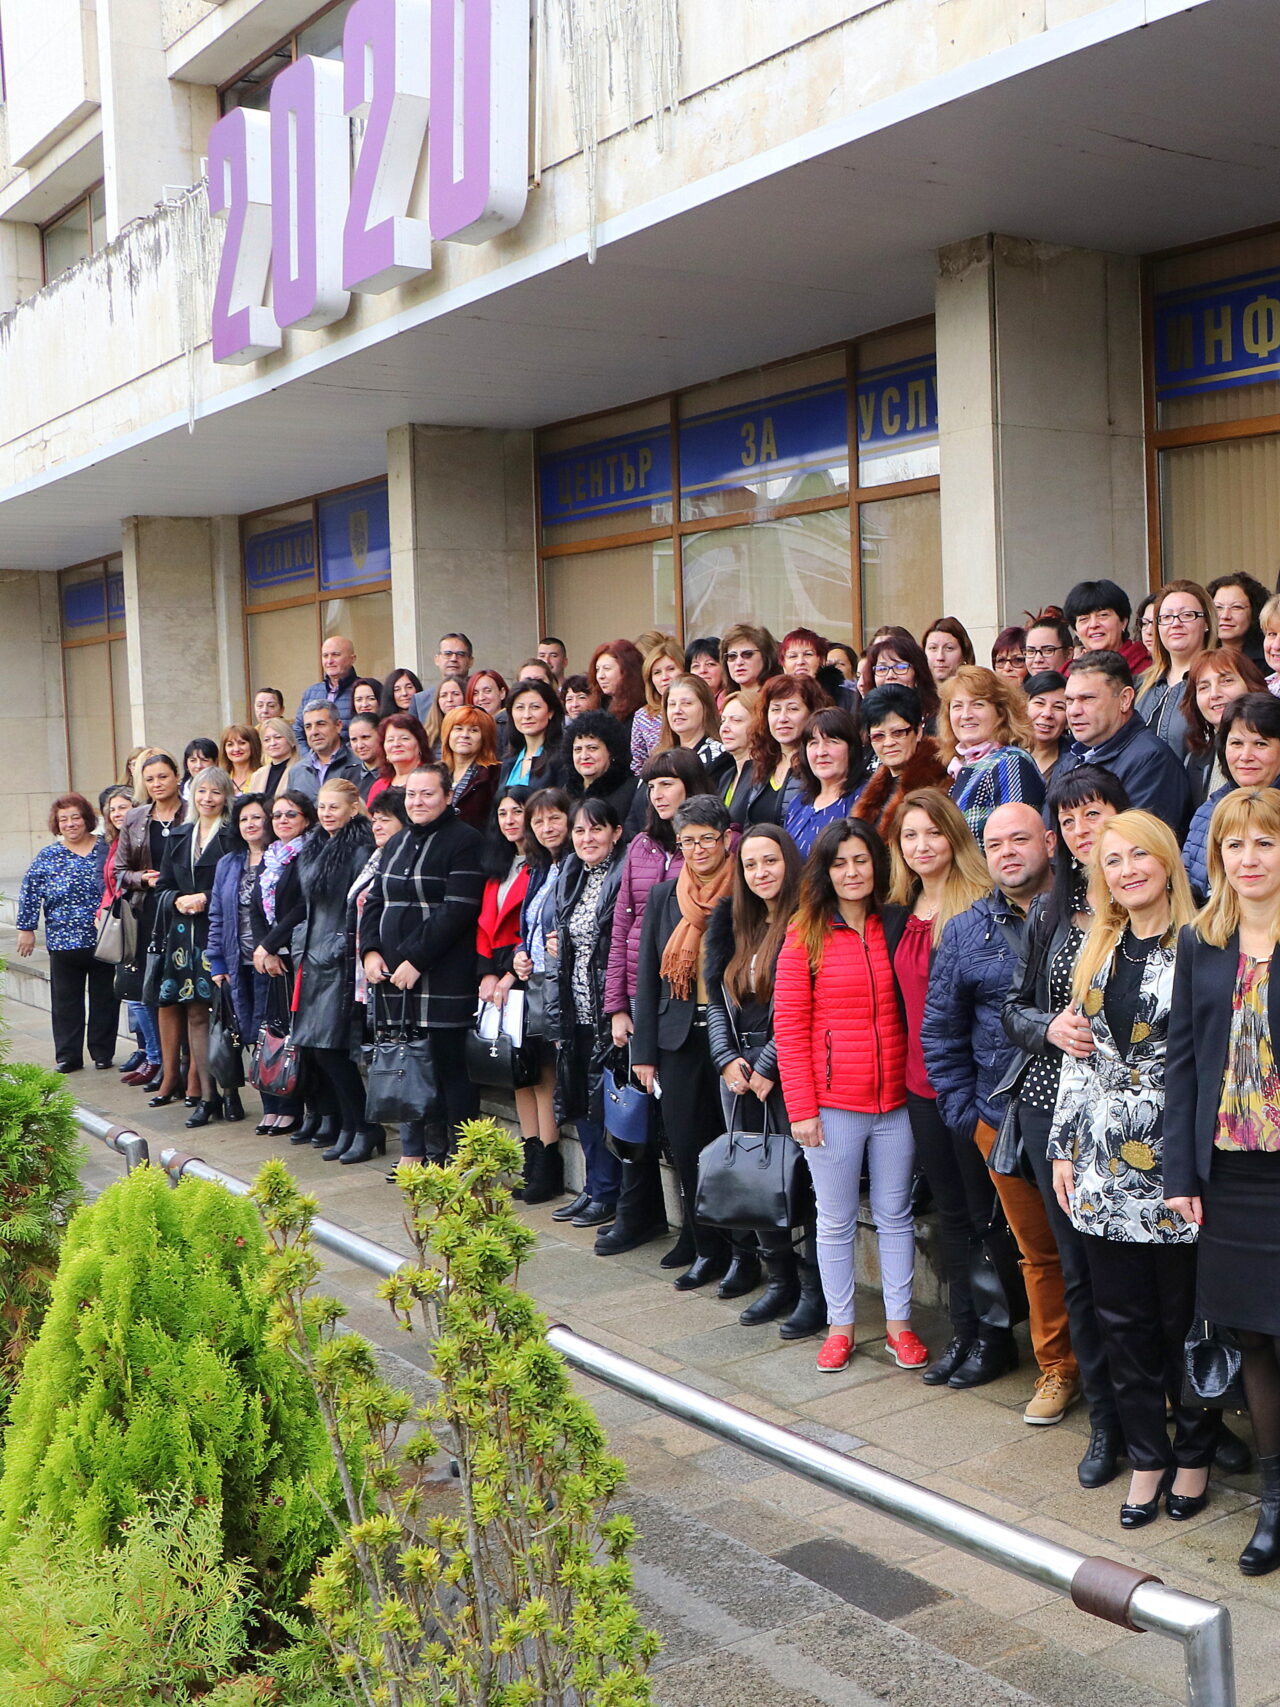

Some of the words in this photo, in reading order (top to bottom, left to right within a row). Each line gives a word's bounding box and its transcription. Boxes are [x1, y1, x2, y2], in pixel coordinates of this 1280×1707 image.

[208, 0, 528, 365] 2020
[559, 447, 653, 510] ЦЕНТЪР
[740, 416, 778, 467] ЗА
